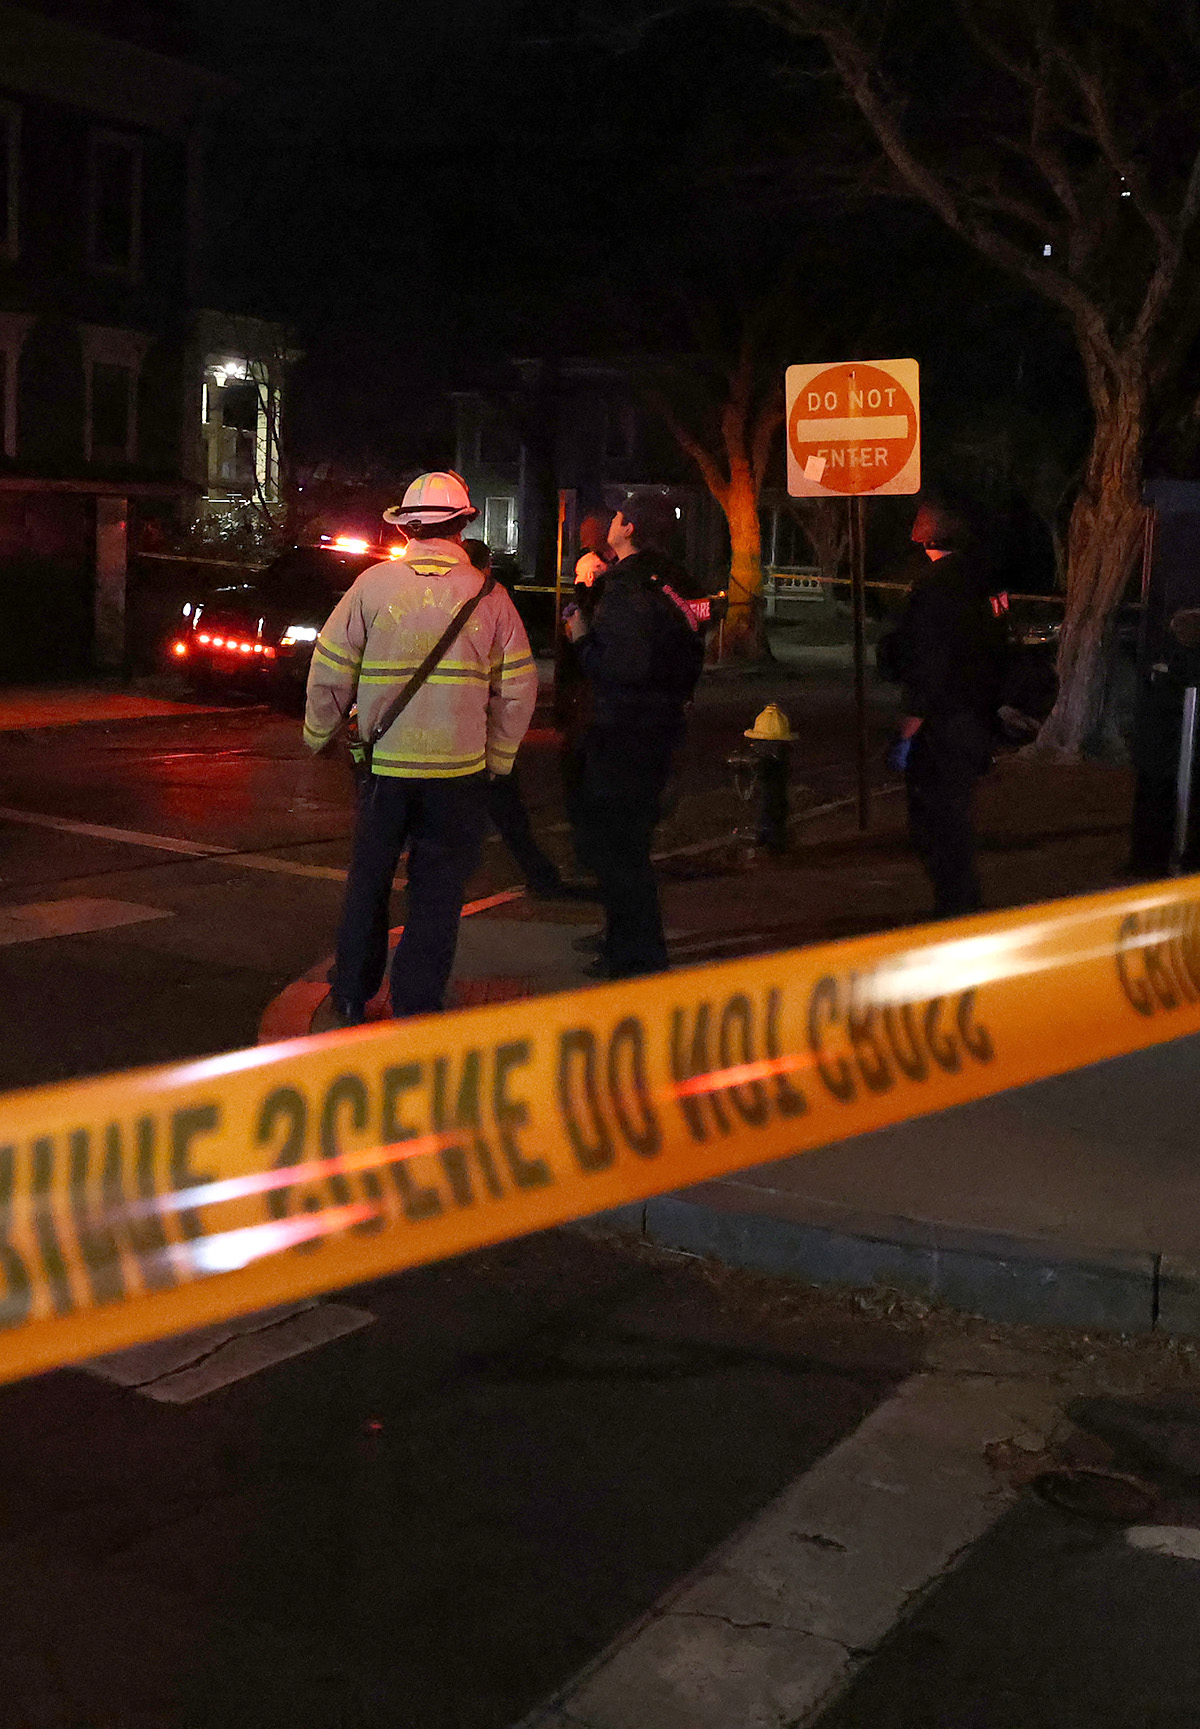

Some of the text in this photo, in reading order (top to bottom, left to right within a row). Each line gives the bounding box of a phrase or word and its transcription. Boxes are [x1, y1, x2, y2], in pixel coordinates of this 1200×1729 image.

[808, 388, 897, 412] DO NOT
[816, 447, 888, 469] ENTER
